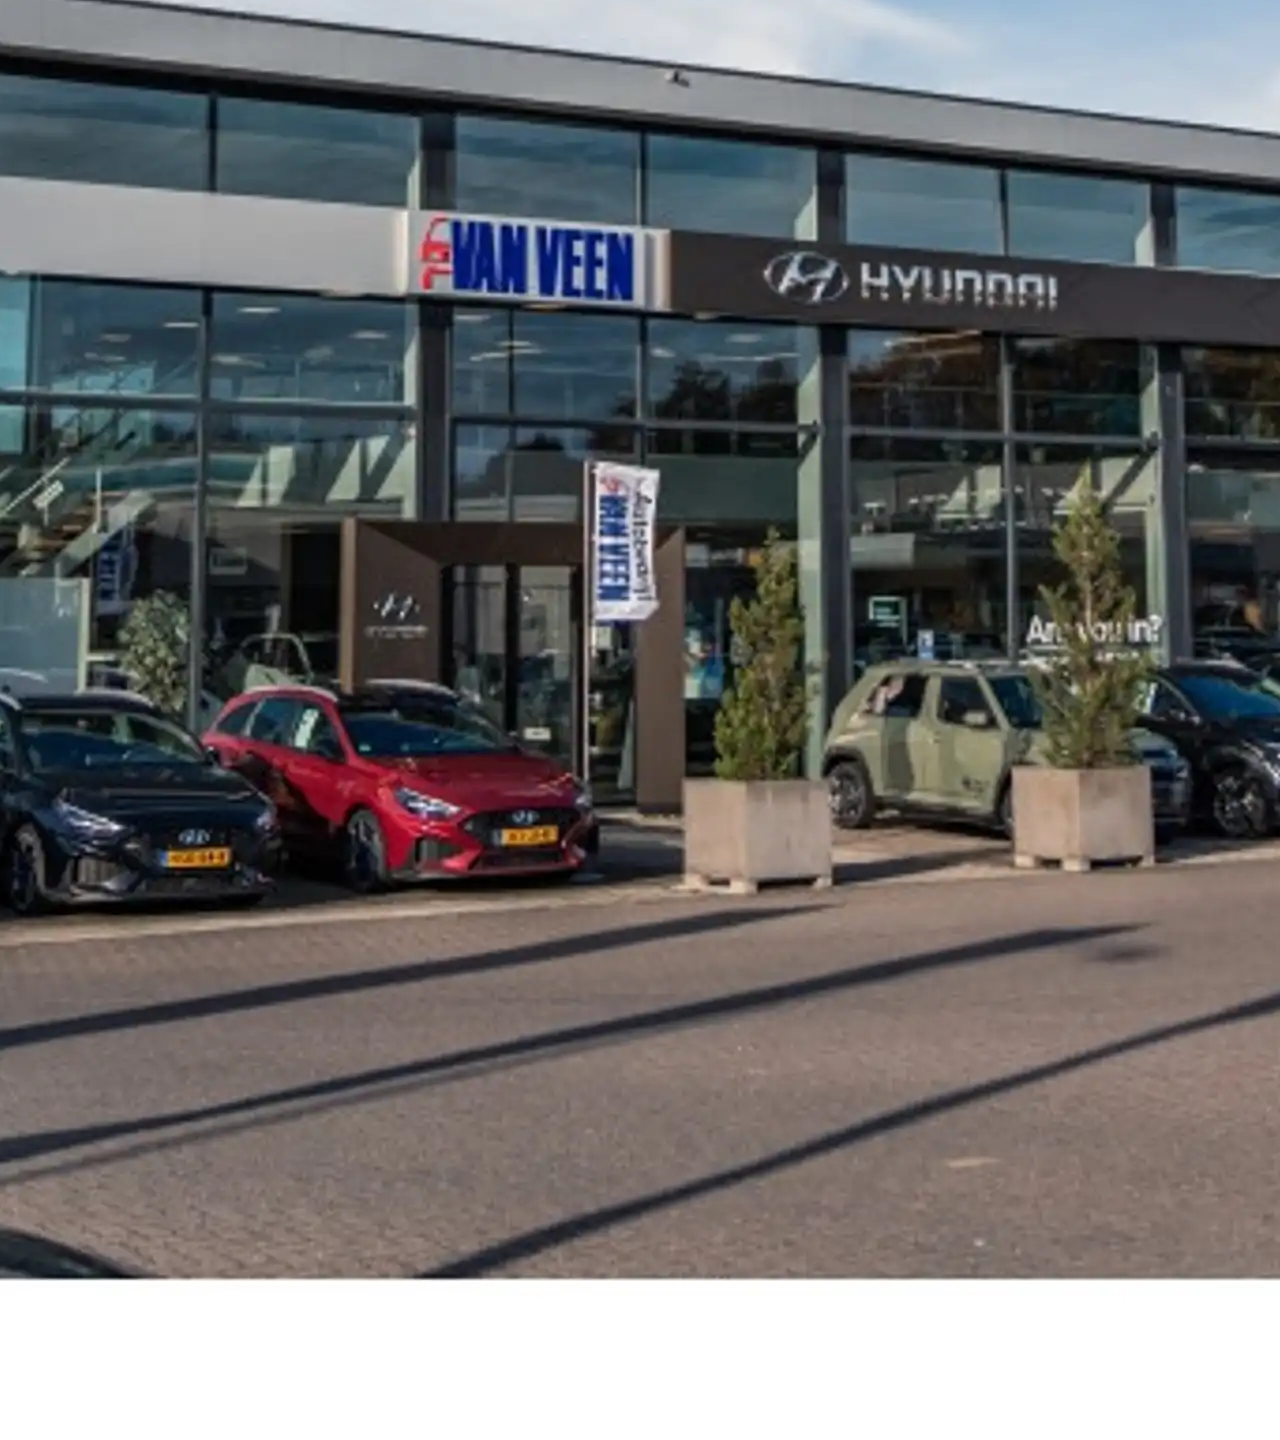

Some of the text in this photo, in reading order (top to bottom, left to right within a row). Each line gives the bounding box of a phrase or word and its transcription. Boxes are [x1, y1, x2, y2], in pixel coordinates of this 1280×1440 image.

[452, 219, 634, 302] VAN VEEN
[860, 262, 1058, 310] HYUNDAI
[598, 495, 630, 601] VAN VEEN
